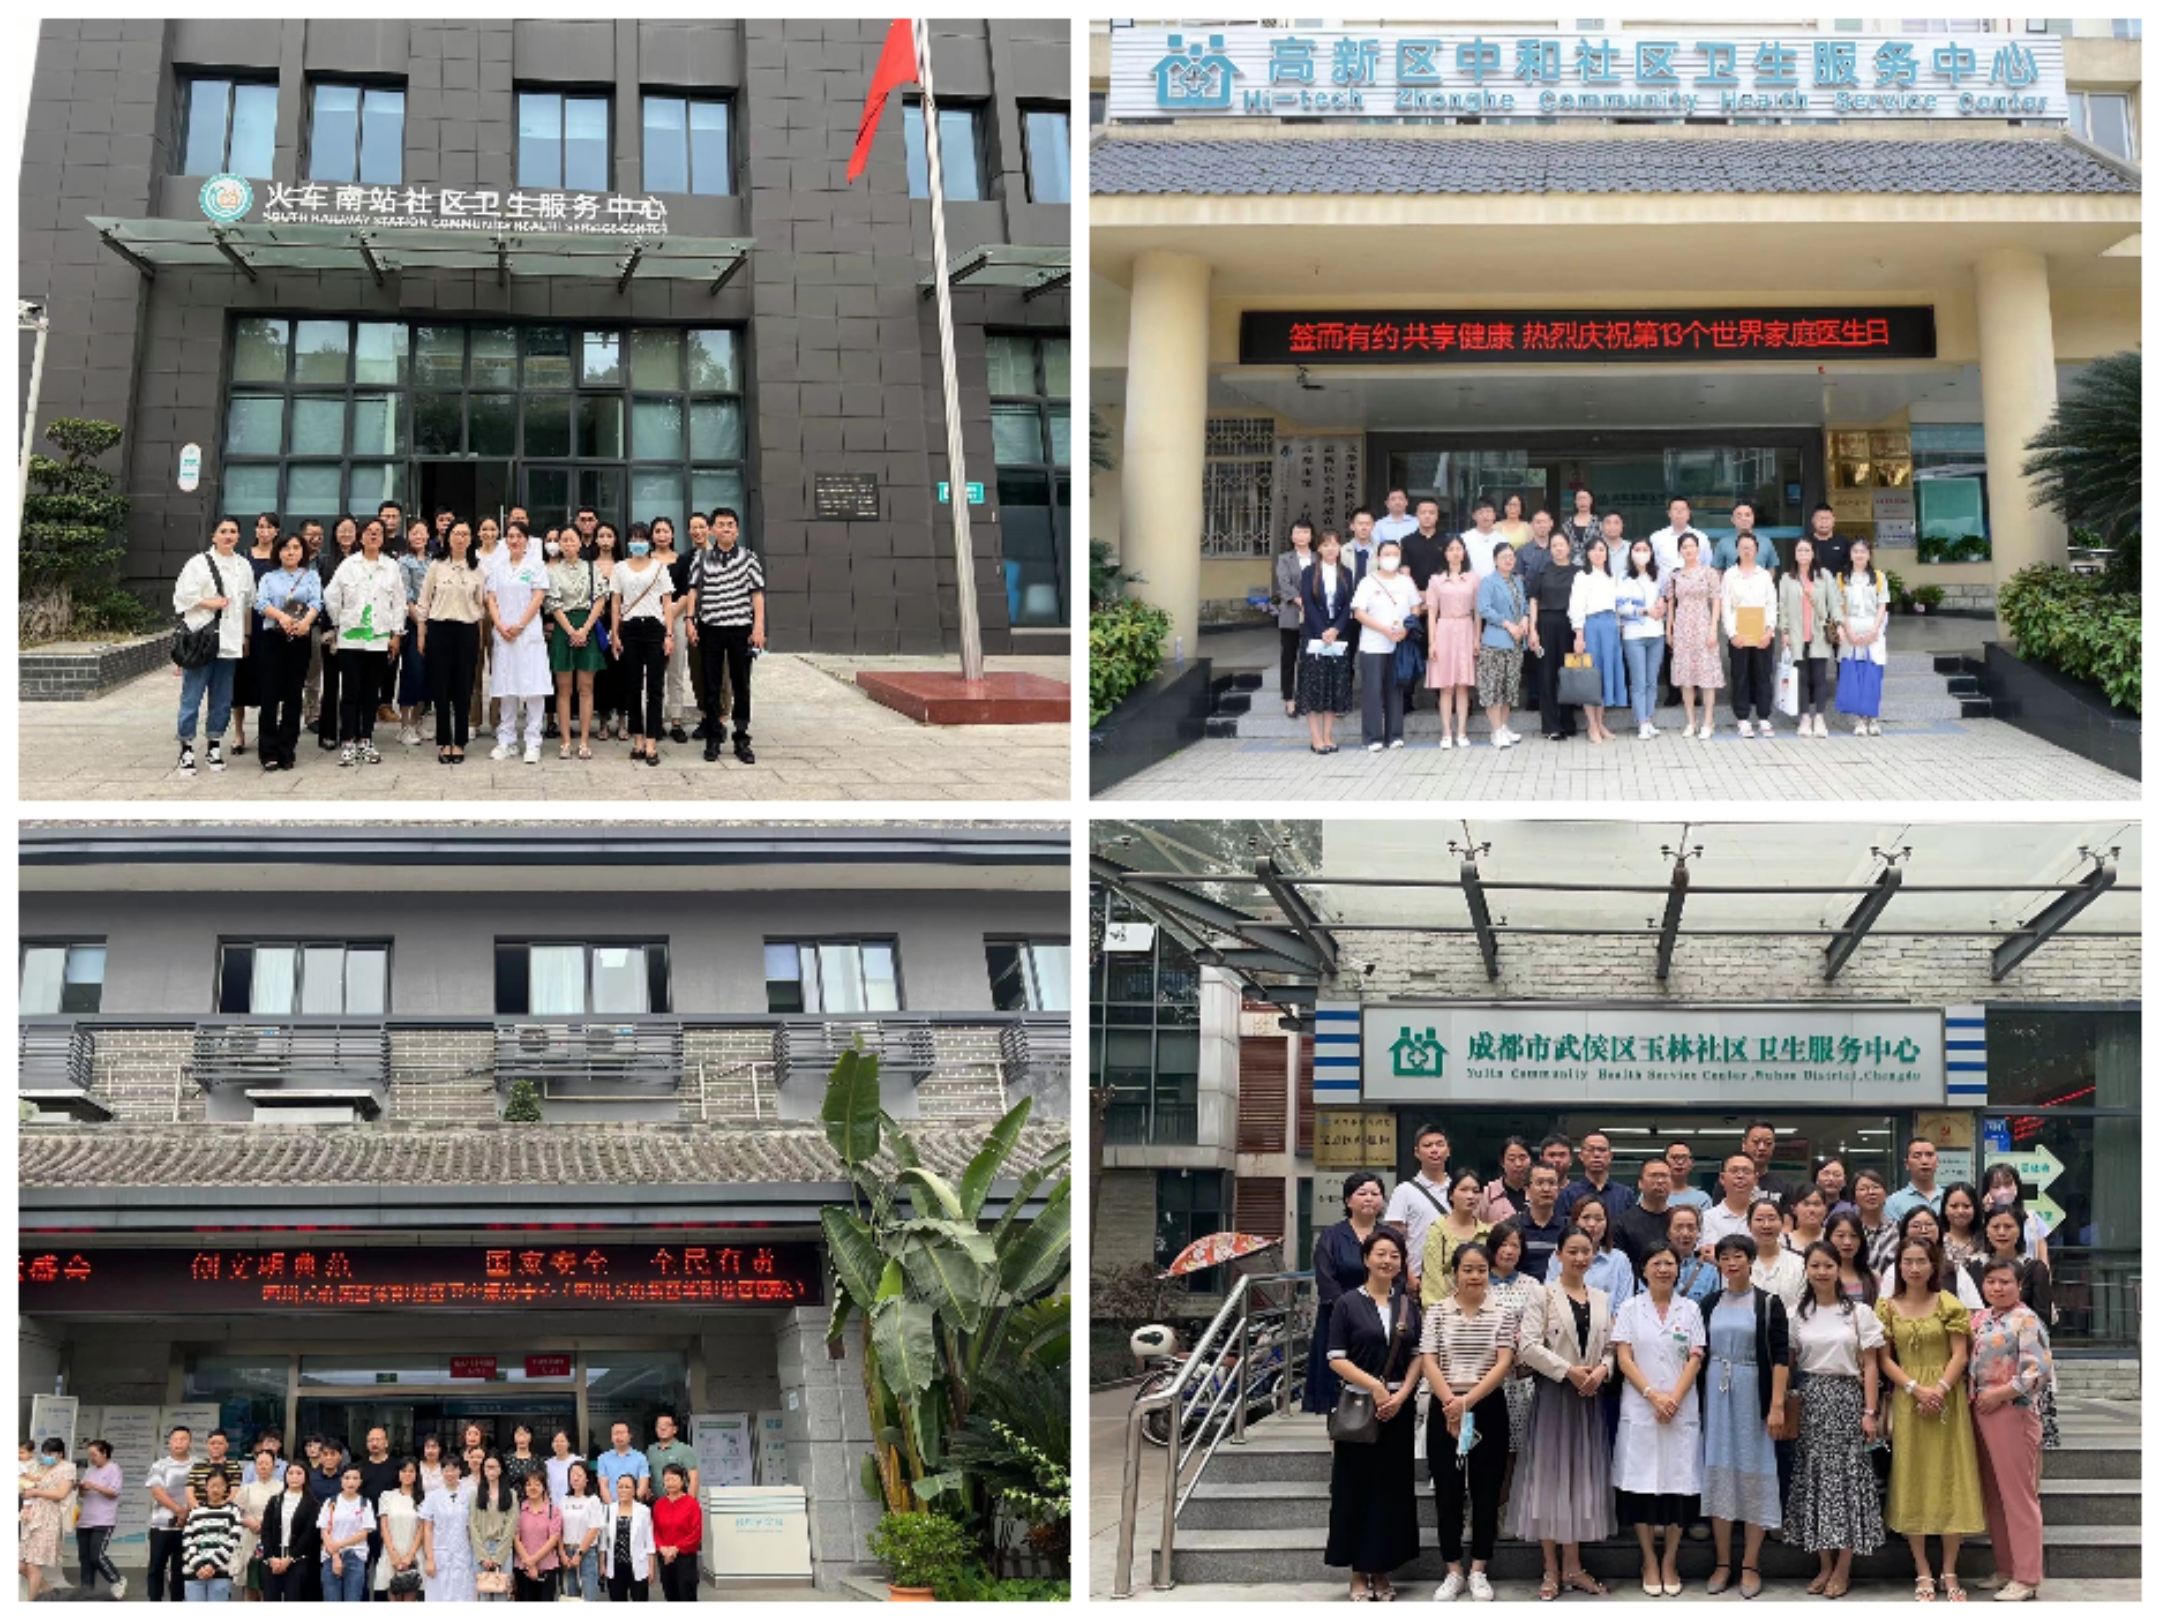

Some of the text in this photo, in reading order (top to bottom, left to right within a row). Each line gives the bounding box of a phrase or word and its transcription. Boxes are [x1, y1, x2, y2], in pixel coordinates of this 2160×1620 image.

[1268, 36, 2040, 88] 高新区中和社区卫生服务中心
[1243, 88, 2050, 115] Hi-tech Zhonghe Community Health Service Center
[264, 181, 668, 221] 火车南站社区卫生服务中心
[1466, 1031, 1921, 1065] 成都市武侯区玉林社区卫生服务中心
[18, 1253, 92, 1283] 盛会
